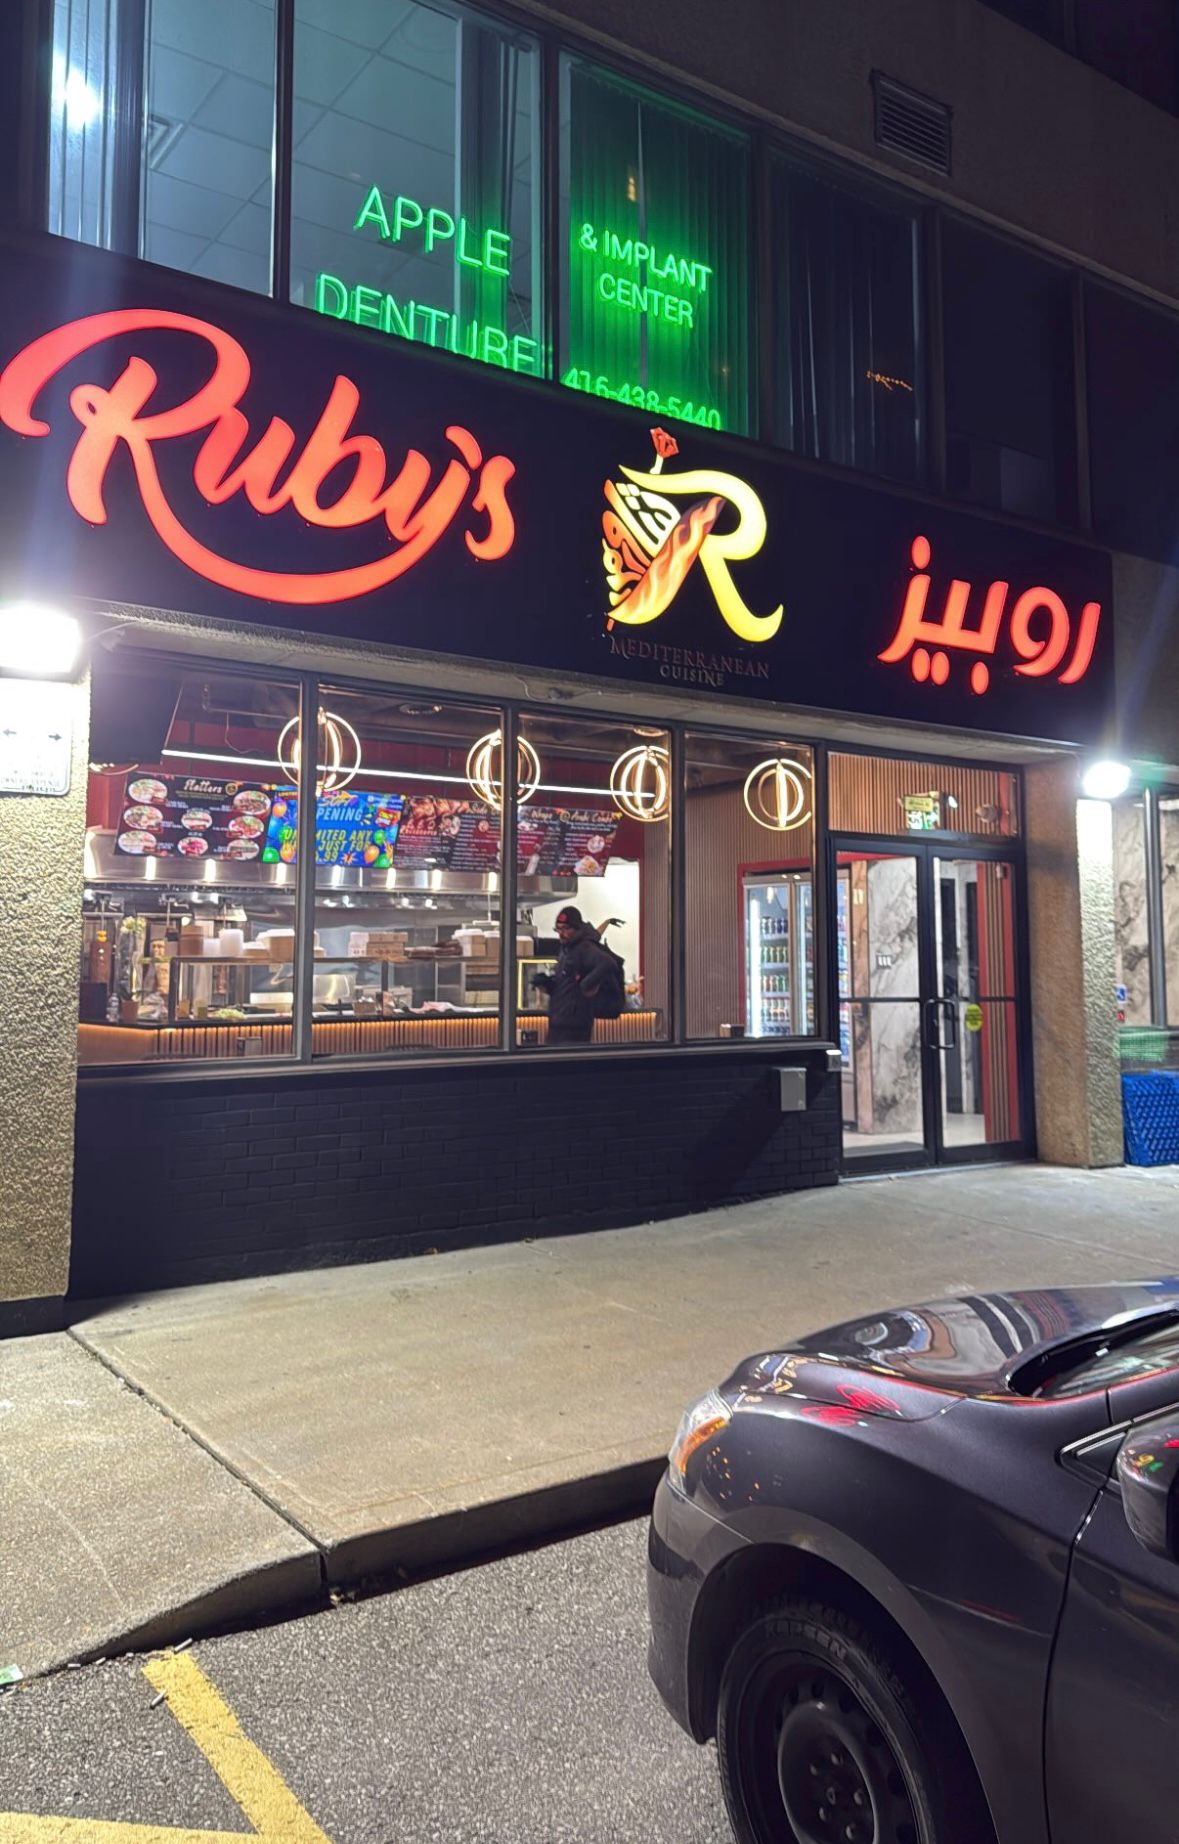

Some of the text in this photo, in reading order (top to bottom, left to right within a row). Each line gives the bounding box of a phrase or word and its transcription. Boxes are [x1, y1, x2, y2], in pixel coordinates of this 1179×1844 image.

[353, 185, 512, 277] APPLE
[578, 222, 713, 293] & IMPLANT
[316, 273, 538, 373] DENTURE
[599, 272, 694, 329] CENTER
[563, 367, 722, 431] 416-438-5440
[0, 308, 516, 605] Ruby's
[876, 535, 1102, 696] روبيز
[610, 635, 770, 680] MEDITERRANEAN
[659, 664, 725, 688] CUISINE
[316, 807, 363, 822] PENING
